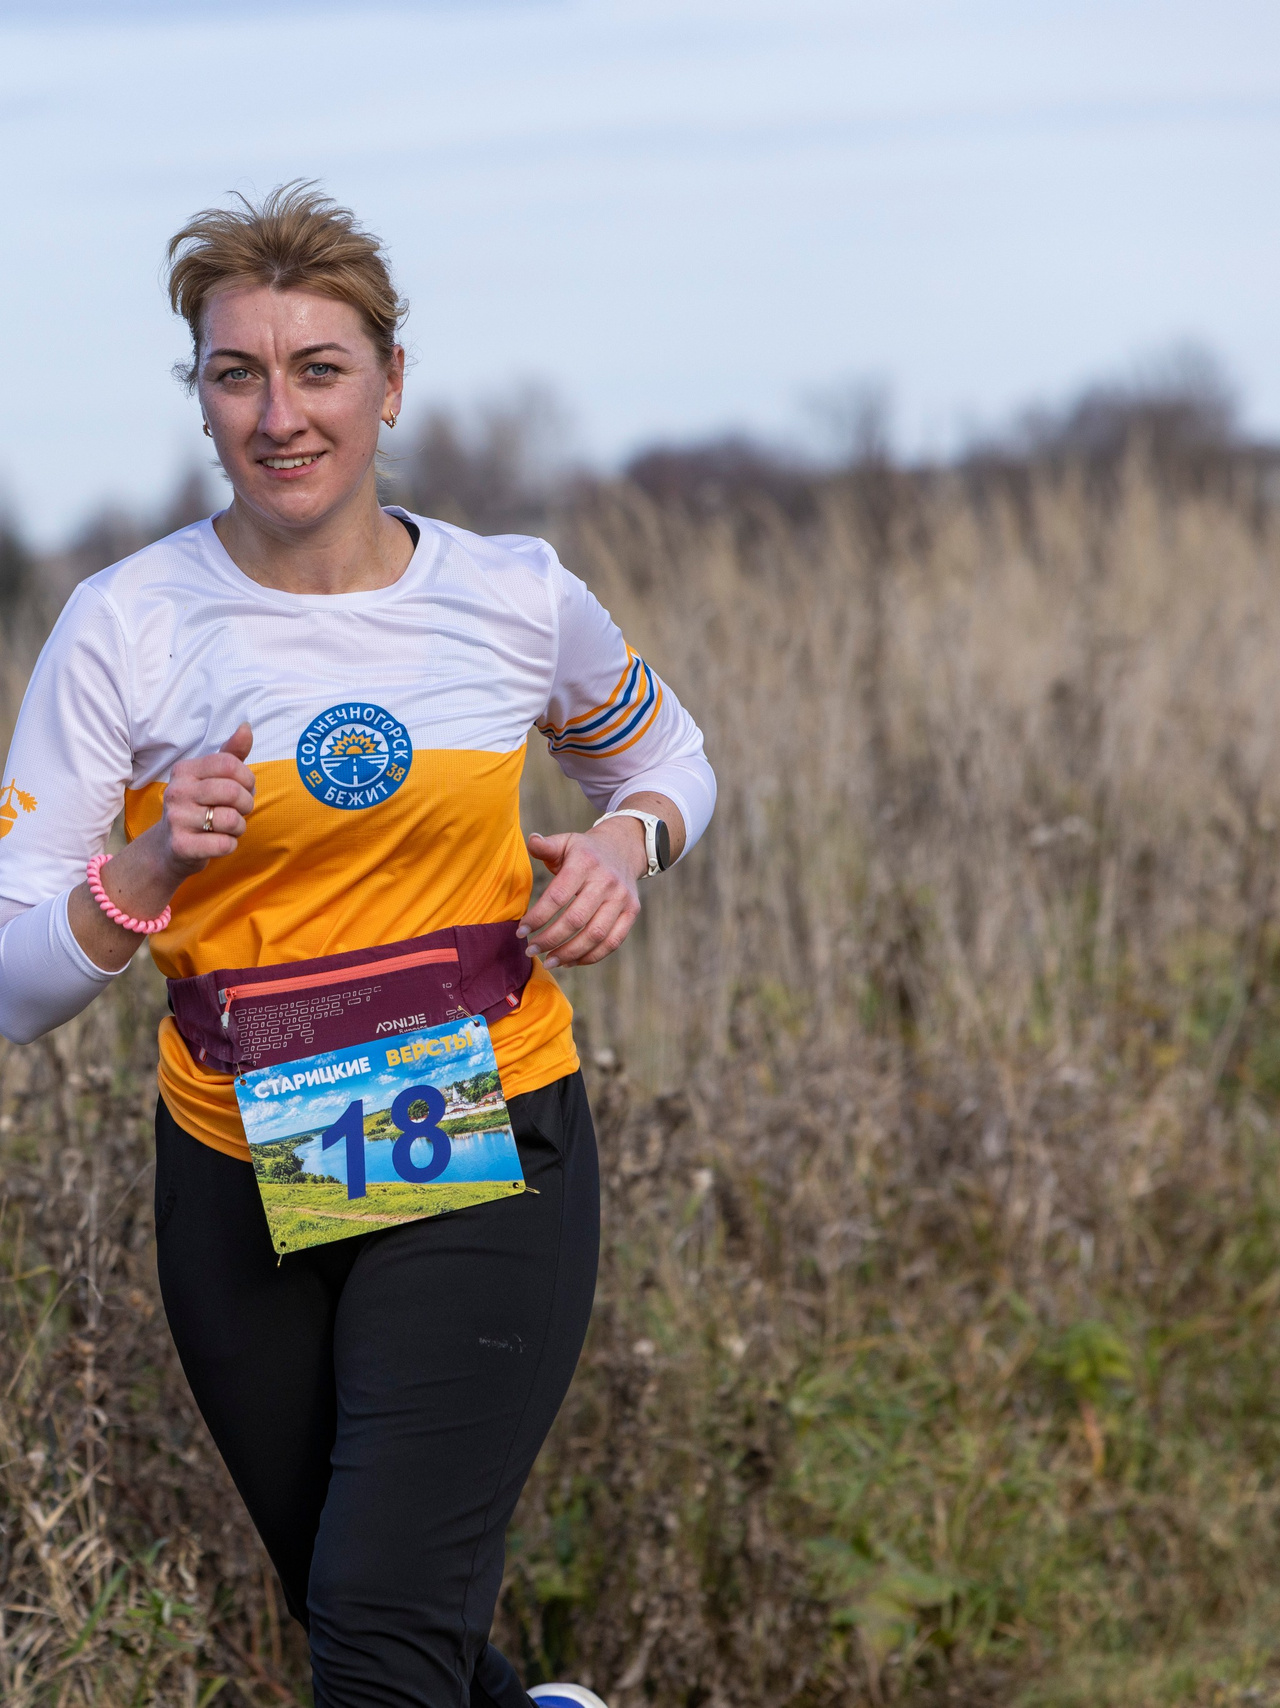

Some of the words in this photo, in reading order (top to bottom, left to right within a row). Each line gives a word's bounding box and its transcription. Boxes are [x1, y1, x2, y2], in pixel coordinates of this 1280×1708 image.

[301, 706, 408, 766] СОЛНЕЧНОГОРСК
[305, 769, 323, 788] 19
[386, 762, 406, 782] 38
[324, 781, 388, 806] БЕЖИТ
[254, 1056, 371, 1099] СТАРИЦКИЕ
[386, 1030, 473, 1067] ВЕРСТЫ
[321, 1084, 452, 1200] 18
